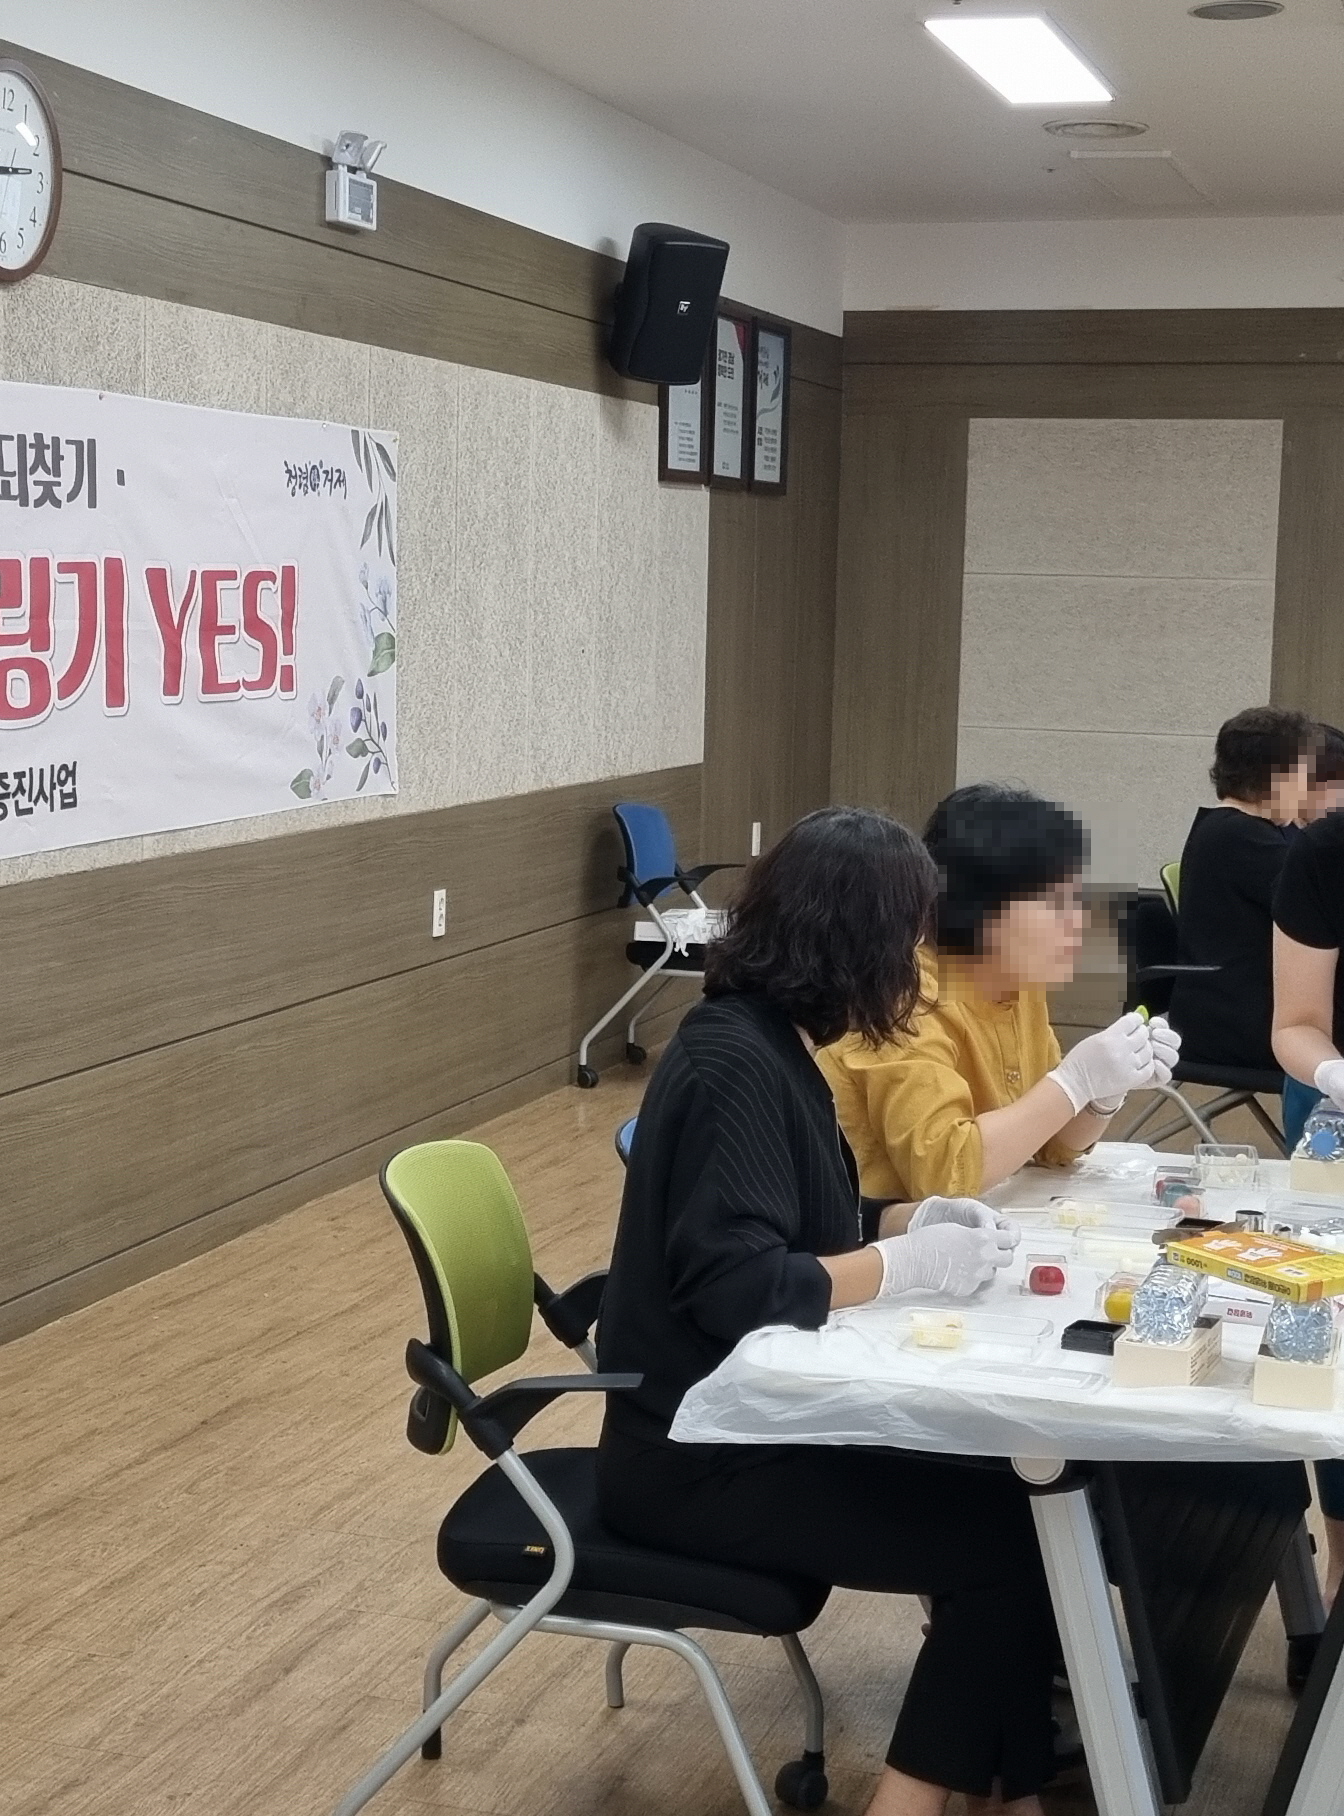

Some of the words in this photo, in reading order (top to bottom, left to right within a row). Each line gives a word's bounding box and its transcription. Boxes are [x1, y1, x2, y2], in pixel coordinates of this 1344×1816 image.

[2, 87, 15, 111] 12
[33, 135, 40, 156] 2
[37, 172, 44, 194] 3
[29, 206, 37, 227] 4
[0, 231, 7, 253] 6
[17, 228, 25, 249] 5
[146, 564, 298, 700] YES!
